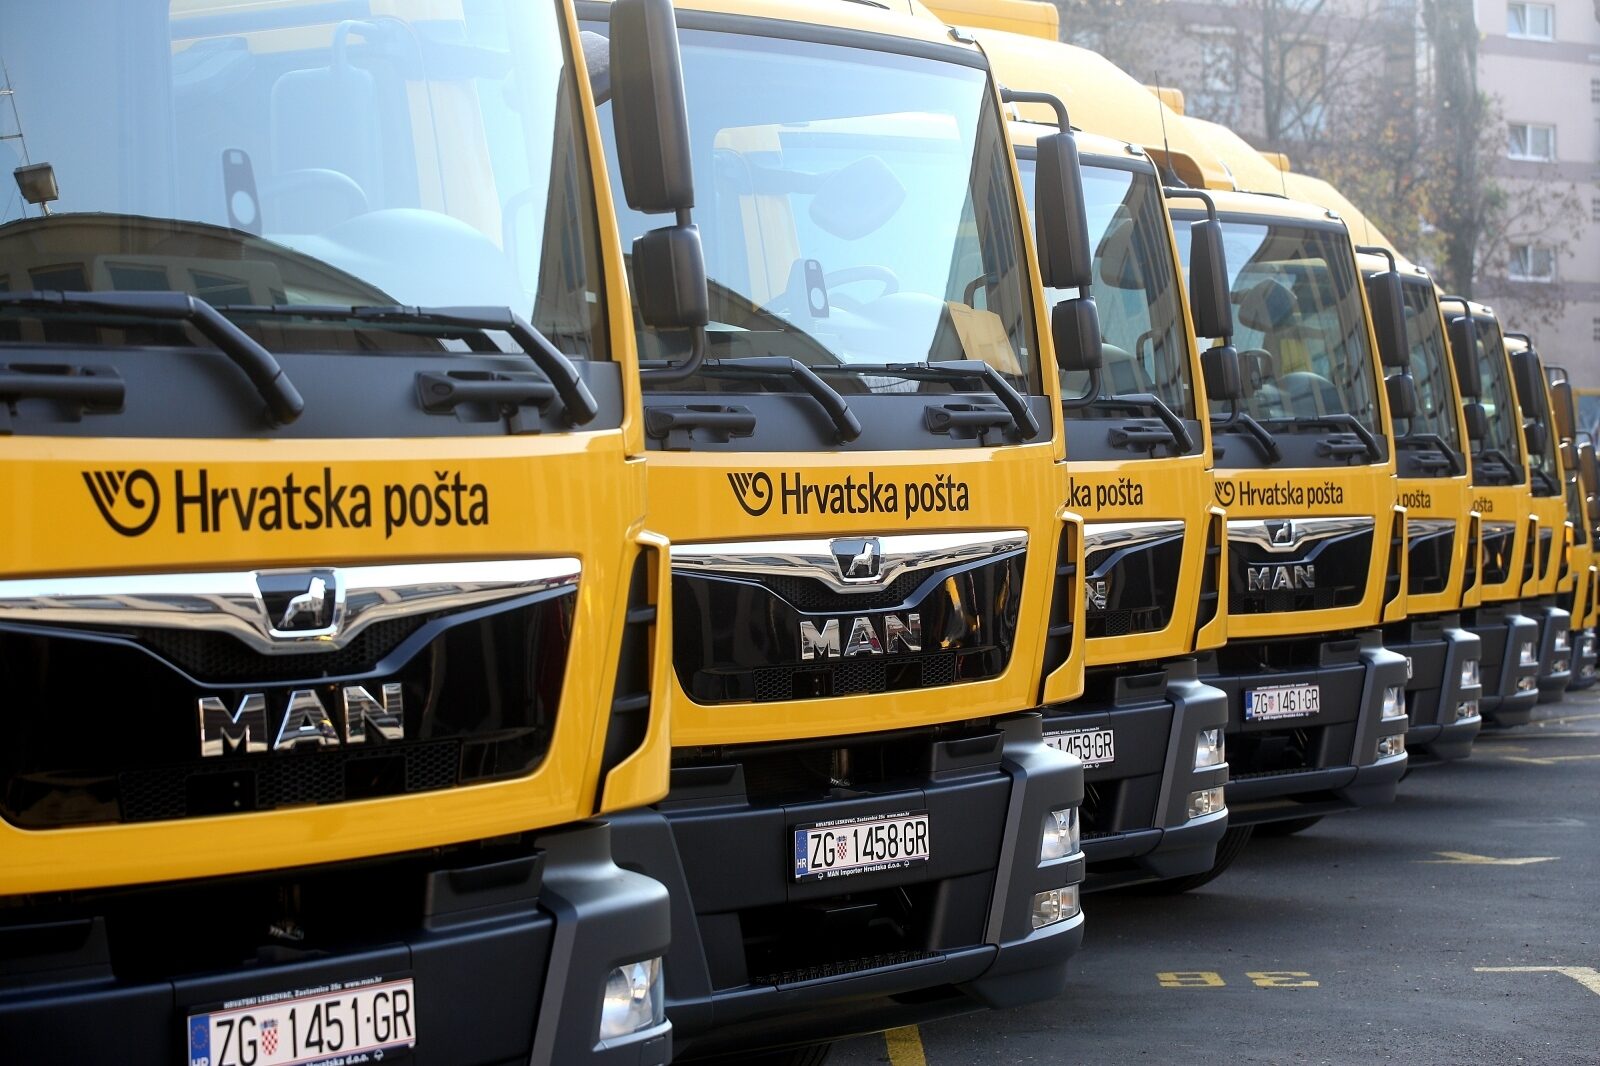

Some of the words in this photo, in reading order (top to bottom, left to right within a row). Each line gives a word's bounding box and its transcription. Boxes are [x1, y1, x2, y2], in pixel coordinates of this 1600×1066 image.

[175, 467, 372, 534] Hrvatska
[384, 470, 489, 540] pošta
[781, 471, 898, 515] Hrvatska
[905, 473, 969, 521] pošta
[1096, 477, 1143, 512] pošta
[1239, 480, 1304, 506] Hrvatska
[1307, 481, 1344, 509] pošta
[1402, 490, 1431, 509] pošta
[1248, 564, 1315, 591] MAN
[800, 613, 922, 660] MAN
[199, 683, 404, 756] MAN
[1254, 693, 1268, 714] ZG
[797, 858, 807, 870] HR
[811, 831, 835, 869] ZG
[827, 869, 839, 878] MAN
[840, 867, 863, 877] Importer
[864, 864, 887, 873] Hrvatska
[216, 1015, 258, 1066] ZG
